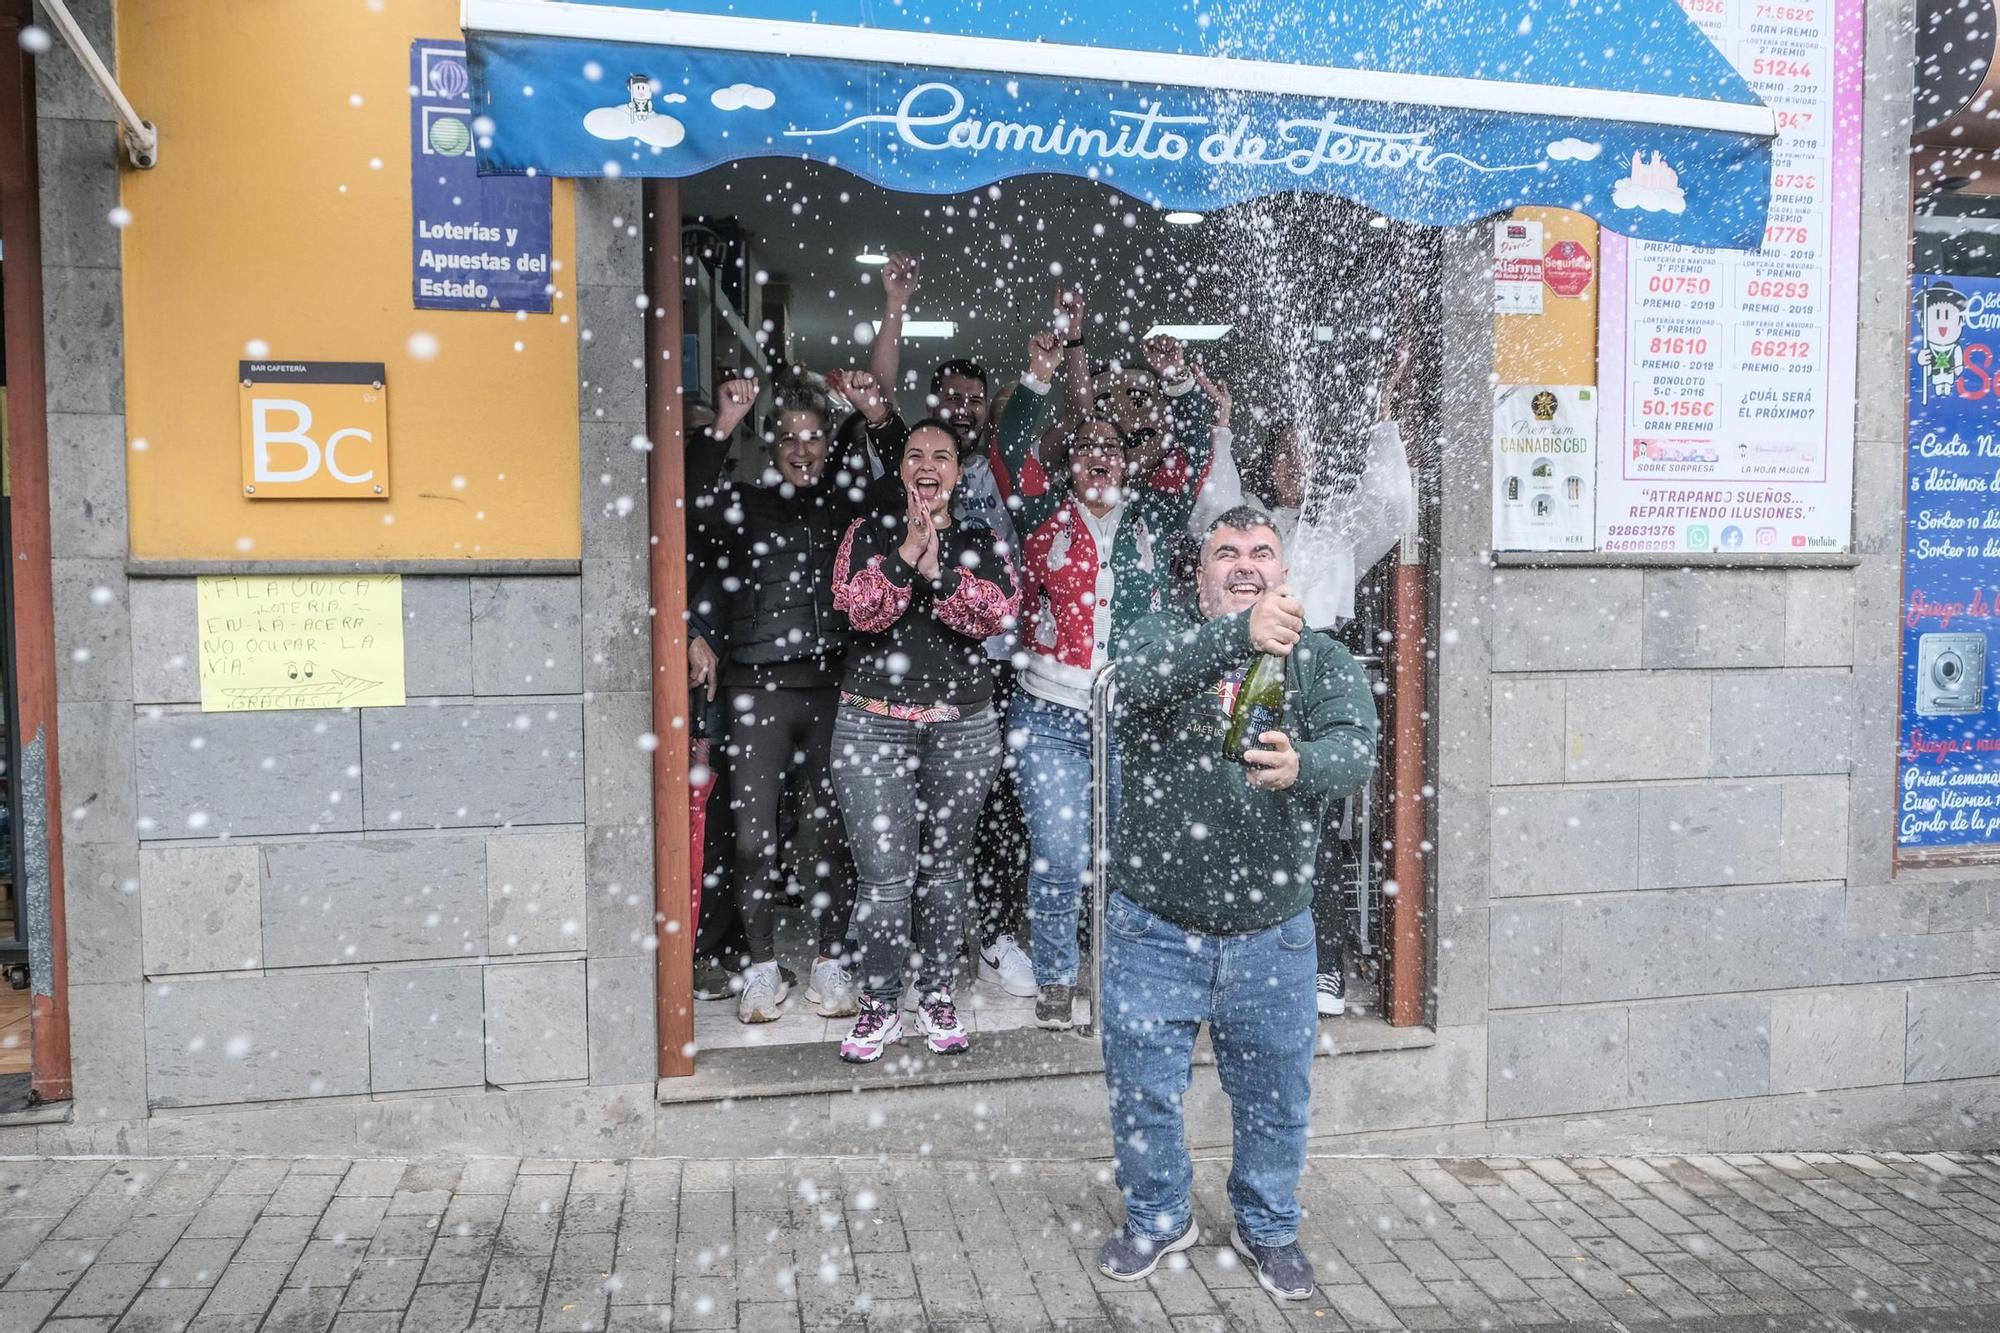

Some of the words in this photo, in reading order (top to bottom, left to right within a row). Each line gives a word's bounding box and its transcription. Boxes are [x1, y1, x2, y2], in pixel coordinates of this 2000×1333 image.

[1750, 24, 1778, 35] GRAN
[1780, 25, 1819, 38] PREMIO
[1771, 47, 1805, 57] PREMIO
[1753, 58, 1812, 78] 51244
[1746, 81, 1784, 91] PREMIO
[1794, 84, 1818, 93] 2017
[1778, 111, 1813, 128] 347
[896, 82, 1207, 161] Caminito
[1199, 114, 1274, 165] de
[1279, 110, 1437, 175] Teror
[1793, 139, 1817, 149] 2018
[1775, 174, 1816, 190] 673€
[1776, 194, 1813, 205] PREMIO
[1768, 214, 1802, 224] PREMIO
[419, 220, 501, 241] Loterías
[505, 228, 518, 247] y
[1766, 226, 1808, 244] 1776
[1644, 243, 1682, 253] PREMIO
[1790, 250, 1815, 259] 2019
[419, 249, 511, 273] Apuestas
[516, 253, 547, 273] del
[1668, 265, 1703, 273] PREMIO
[1767, 269, 1801, 278] PREMIO
[420, 278, 489, 298] Estado
[1649, 276, 1710, 294] 00750
[1748, 281, 1809, 298] 06293
[1643, 299, 1680, 309] PREMIO
[1690, 301, 1715, 310] 2019
[1742, 303, 1779, 313] PREMIO
[1789, 305, 1814, 314] 2019
[1667, 326, 1702, 334] PREMIO
[1766, 328, 1801, 338] PREMIO
[1650, 338, 1707, 354] 81610
[1750, 340, 1810, 358] 66212
[251, 364, 266, 372] BAR
[267, 364, 307, 372] CAFETERÍA
[1642, 360, 1680, 369] PREMIO
[1689, 361, 1714, 370] 2019
[1741, 363, 1779, 373] PREMIO
[1788, 364, 1813, 373] 2019
[1653, 376, 1706, 386] BONOLOTO
[1741, 386, 1778, 404] ¿CUÁL
[1782, 387, 1812, 402] SERÁ
[1642, 400, 1715, 417] 50.156€
[1739, 408, 1752, 418] EL
[1755, 404, 1815, 419] PRÓXIMO?
[1644, 421, 1672, 430] GRAN
[1675, 422, 1714, 431] PREMIO
[252, 398, 373, 483] Bc
[1501, 438, 1561, 453] CANNABIS
[1564, 438, 1587, 453] CBD
[1637, 463, 1666, 472] SOBRE
[1669, 464, 1715, 473] SORPRESA
[1741, 466, 1751, 474] LA
[1753, 466, 1777, 474] HOJA
[1911, 477, 1920, 491] 5
[1925, 467, 1988, 491] décimos
[1629, 505, 1727, 519] REPARTIENDO
[1967, 517, 1979, 529] 10
[1608, 525, 1676, 536] 928631376
[1565, 536, 1584, 544] HERE
[1808, 535, 1837, 547] YouTube
[1966, 545, 1978, 558] 10
[1968, 590, 1988, 616] de
[204, 640, 234, 655] NO
[341, 635, 375, 649] LA
[1185, 723, 1225, 738] AMERIC
[1904, 767, 1946, 790] Primi
[1903, 791, 1939, 812] Euro
[1941, 790, 1993, 809] Viernes
[1901, 810, 1948, 837] Gordo
[1950, 809, 1968, 831] de
[1971, 808, 1985, 830] la
